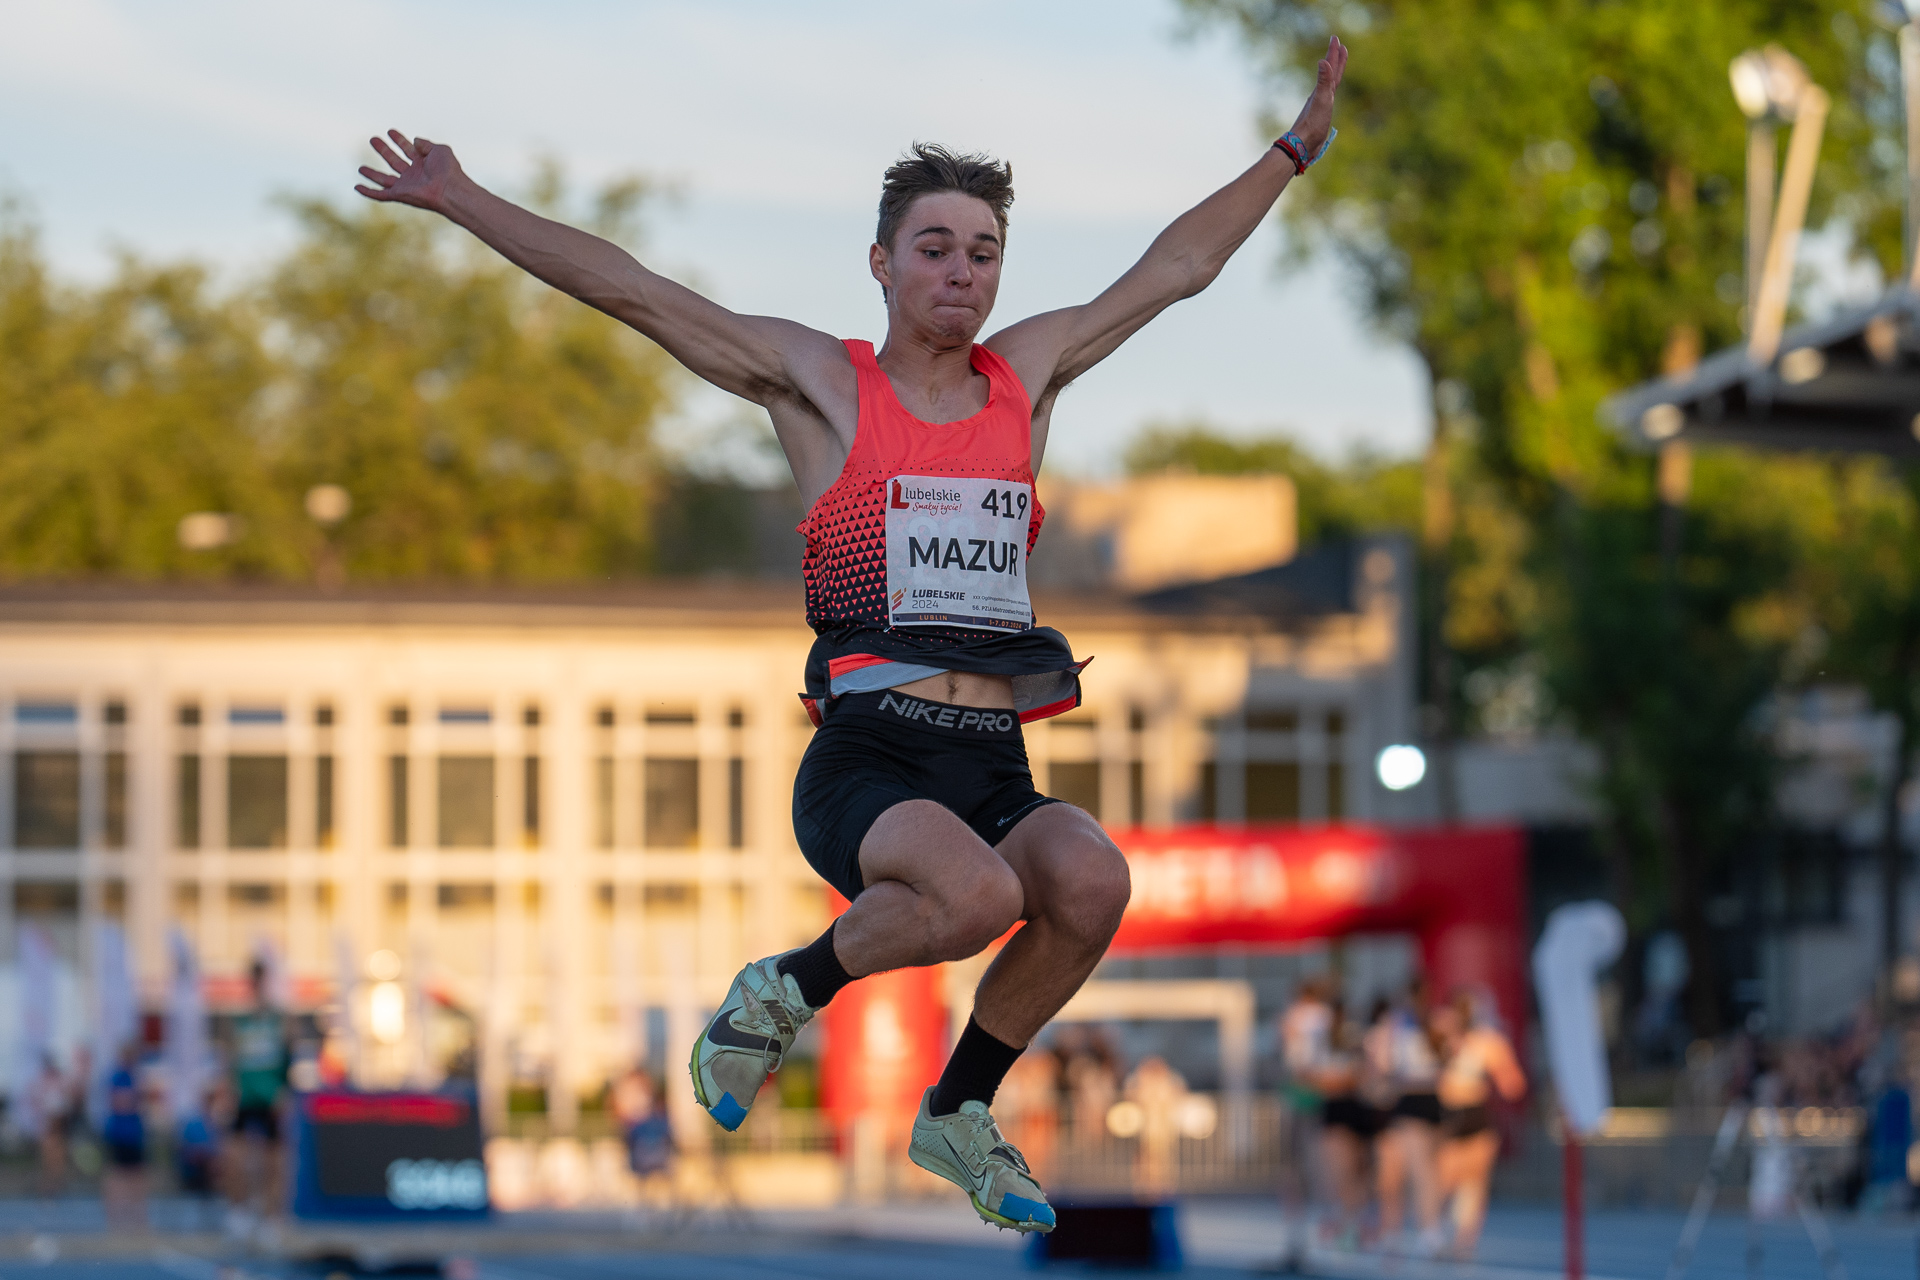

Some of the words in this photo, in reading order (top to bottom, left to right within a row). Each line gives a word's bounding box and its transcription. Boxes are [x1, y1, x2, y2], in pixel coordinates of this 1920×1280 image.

[981, 488, 1028, 521] 419
[908, 536, 1019, 577] MAZUR
[911, 589, 966, 601] LUBELSKIE
[911, 599, 939, 609] 2024
[877, 692, 960, 728] NIKE
[957, 712, 1013, 732] PRO
[761, 999, 794, 1036] NIKE
